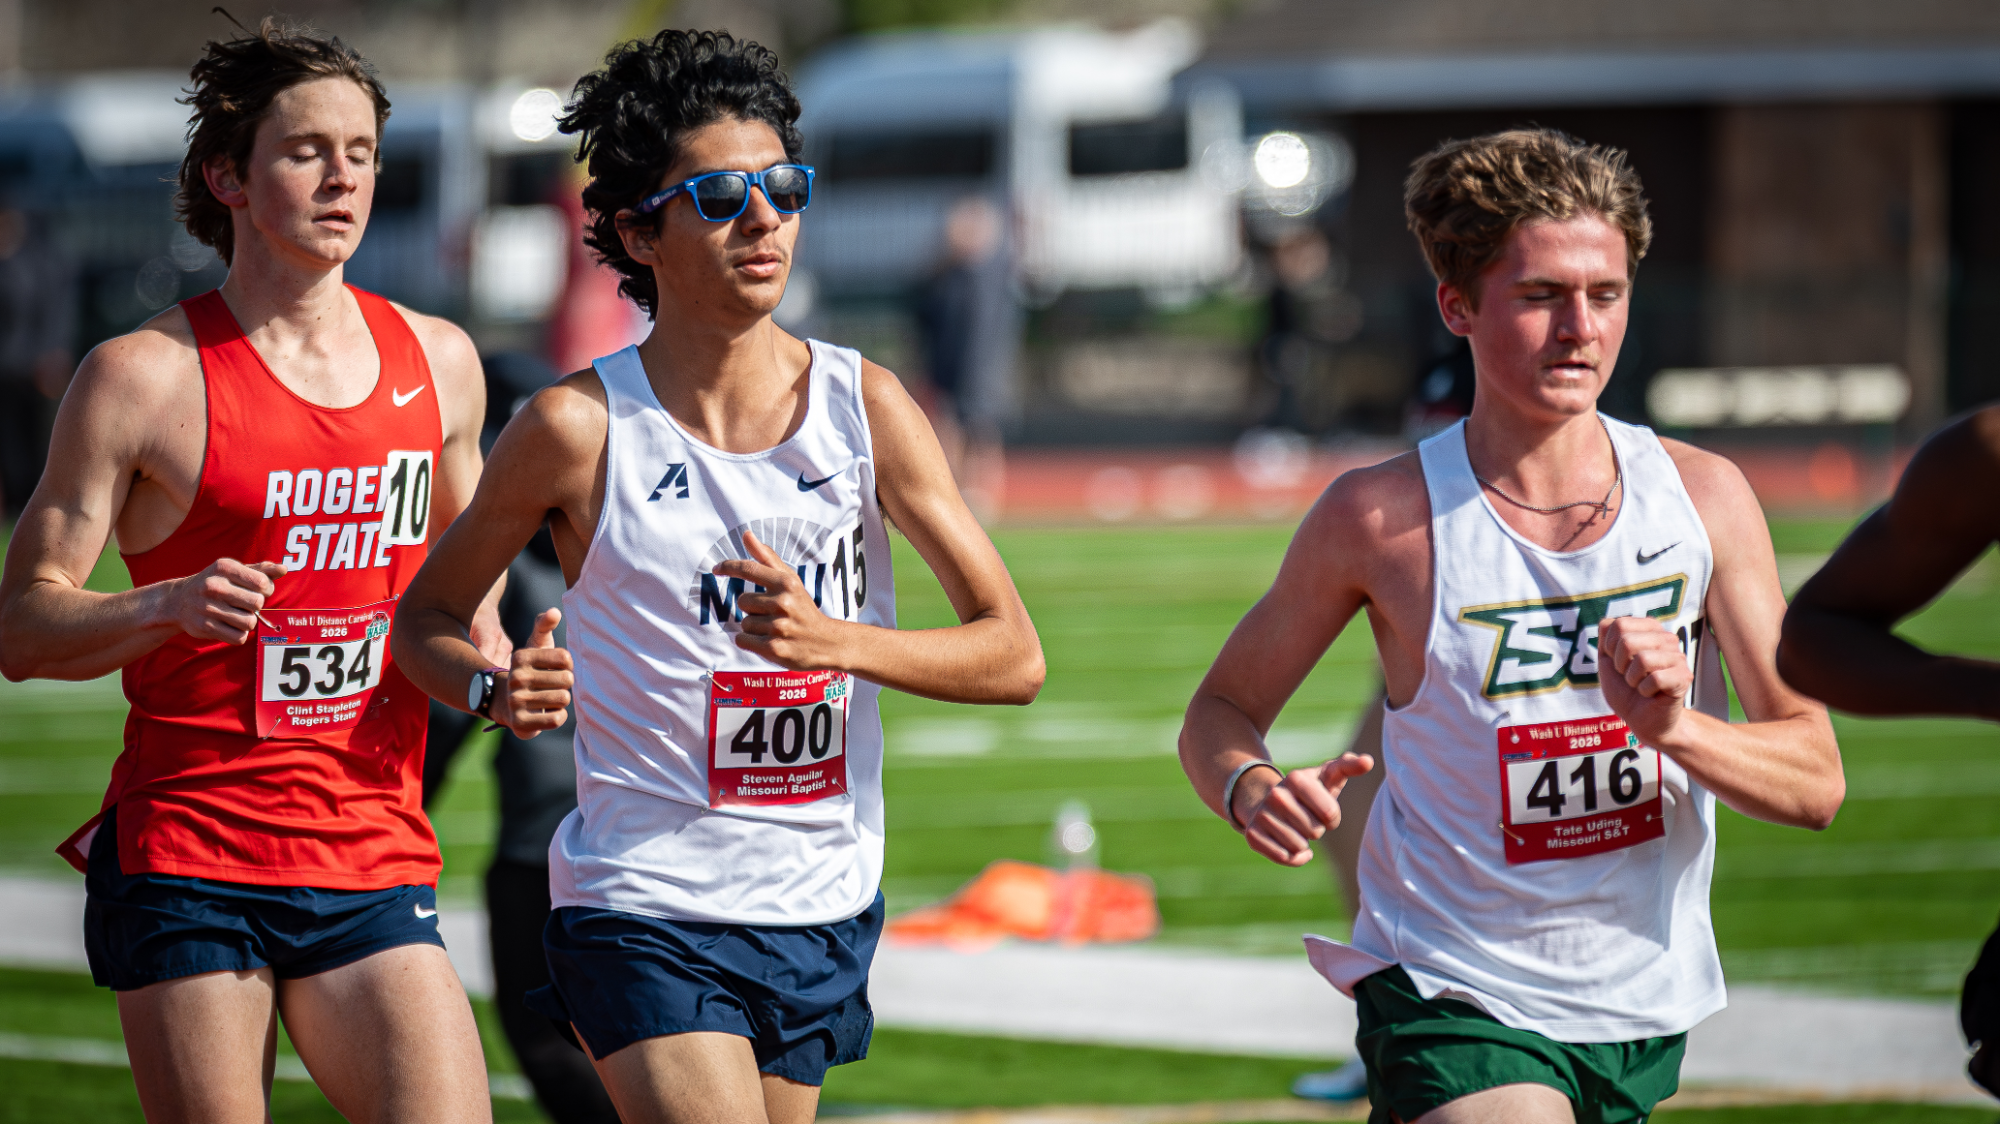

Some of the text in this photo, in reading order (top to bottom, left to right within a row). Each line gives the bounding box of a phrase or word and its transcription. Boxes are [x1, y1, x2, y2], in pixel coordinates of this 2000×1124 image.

[390, 458, 430, 539] 10
[832, 522, 867, 620] 15
[700, 563, 827, 625] MU
[287, 610, 373, 627] Wash U Distance Carnival
[320, 627, 348, 638] 2026
[278, 639, 371, 698] 534
[743, 670, 831, 688] Wash U Distance Carnival
[779, 688, 807, 700] 2026
[286, 699, 361, 715] Clint Stapleton
[292, 711, 357, 727] Rogers State
[730, 703, 832, 765] 400
[1529, 726, 1554, 741] Wash
[1554, 726, 1562, 738] U
[1563, 723, 1599, 738] Distance
[1569, 734, 1602, 749] 2026
[742, 770, 824, 784] Steven Aguilar
[1526, 749, 1642, 817] 416
[737, 779, 827, 796] Missouri Baptist
[1553, 818, 1622, 837] Tate Uding
[1546, 825, 1630, 849] Missouri S&T
